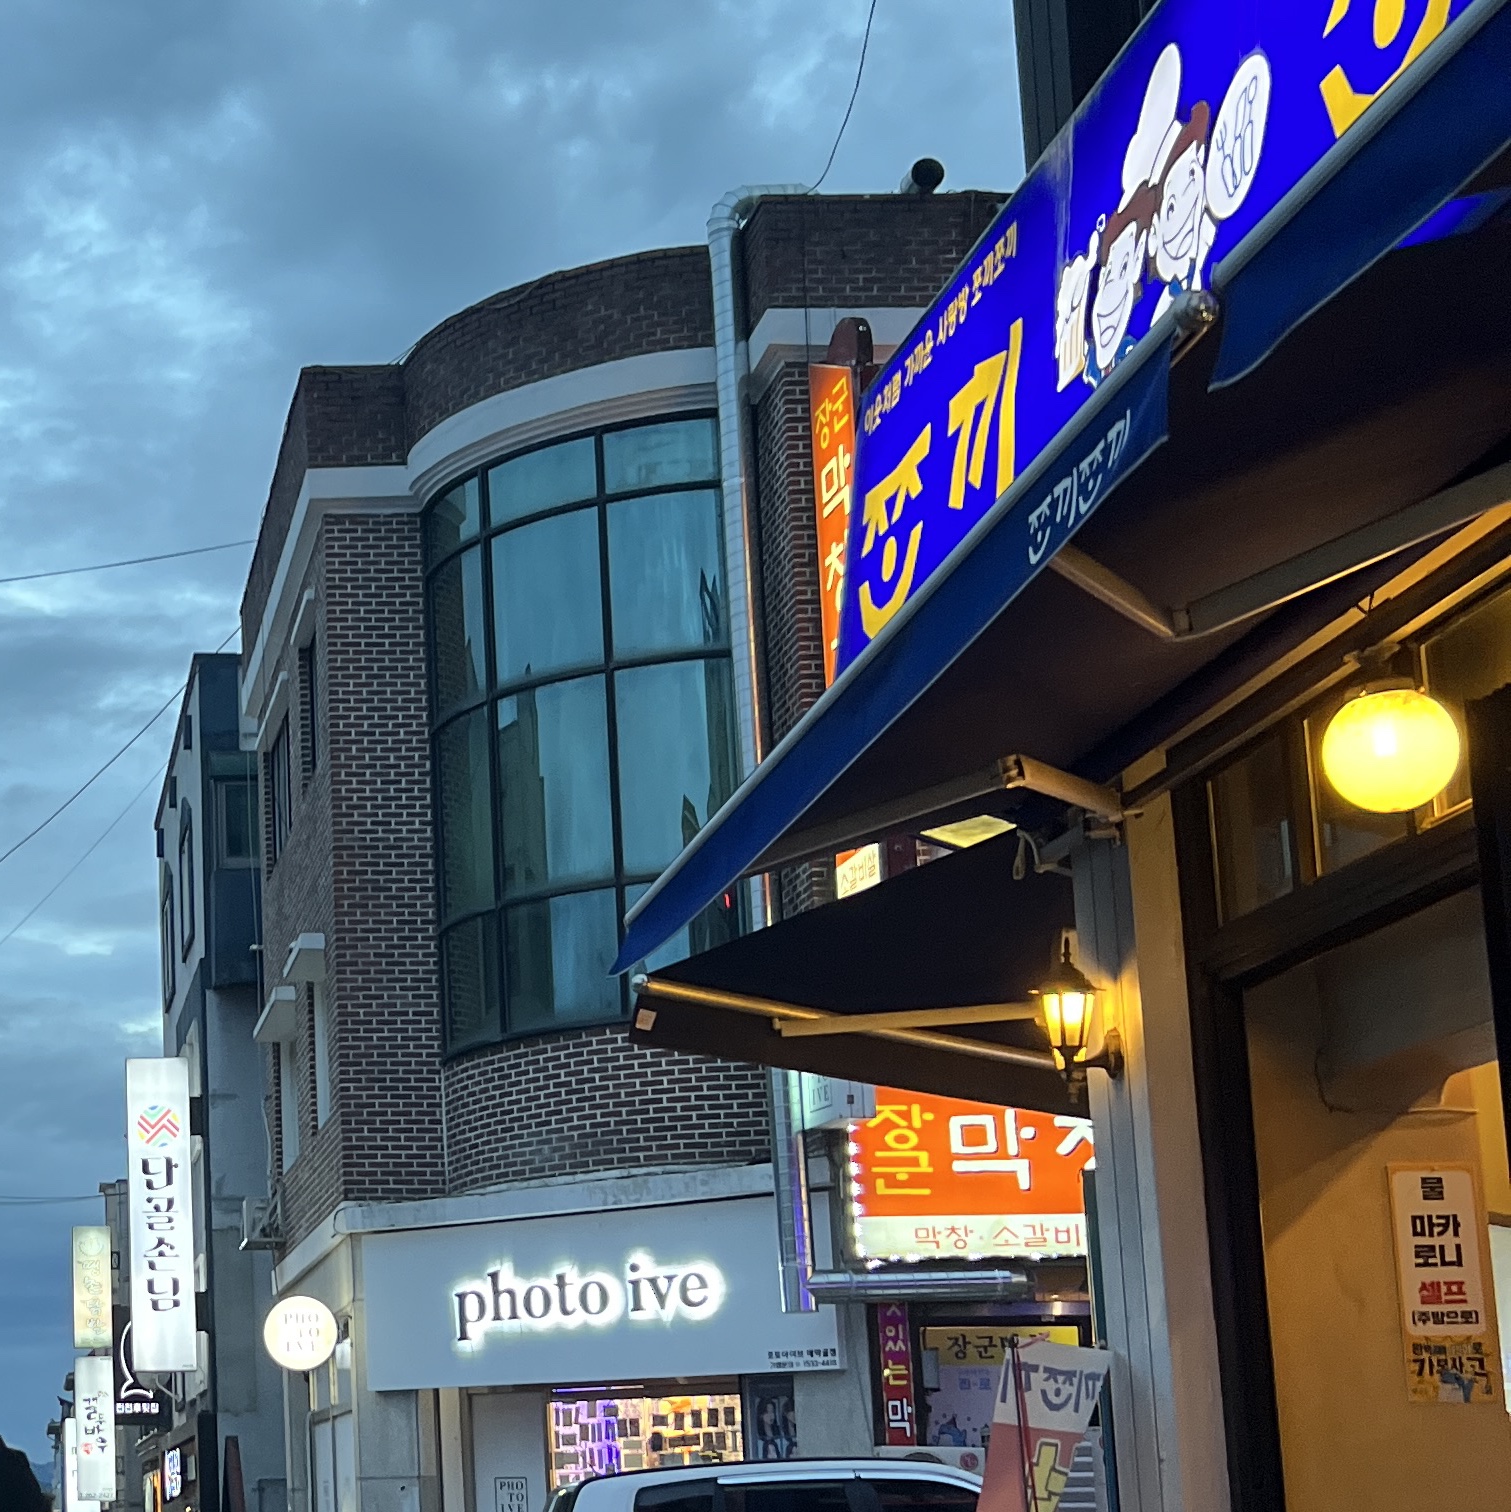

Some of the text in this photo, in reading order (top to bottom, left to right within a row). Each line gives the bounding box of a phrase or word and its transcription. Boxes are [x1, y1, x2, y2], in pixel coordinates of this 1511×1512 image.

[864, 369, 901, 435] 이웃처럼
[936, 283, 969, 346] 사랑방
[815, 375, 849, 449] 장군
[866, 1104, 935, 1195] 장군
[1420, 1176, 1445, 1201] 물
[141, 1156, 180, 1312] 단골손님
[1410, 1213, 1462, 1238] 마카
[1413, 1243, 1464, 1269] 로니
[454, 1262, 709, 1341] photo ive
[1418, 1280, 1468, 1306] 셀프
[499, 1480, 524, 1491] PHO
[507, 1492, 524, 1502] TO
[500, 1503, 524, 1512] IVE
